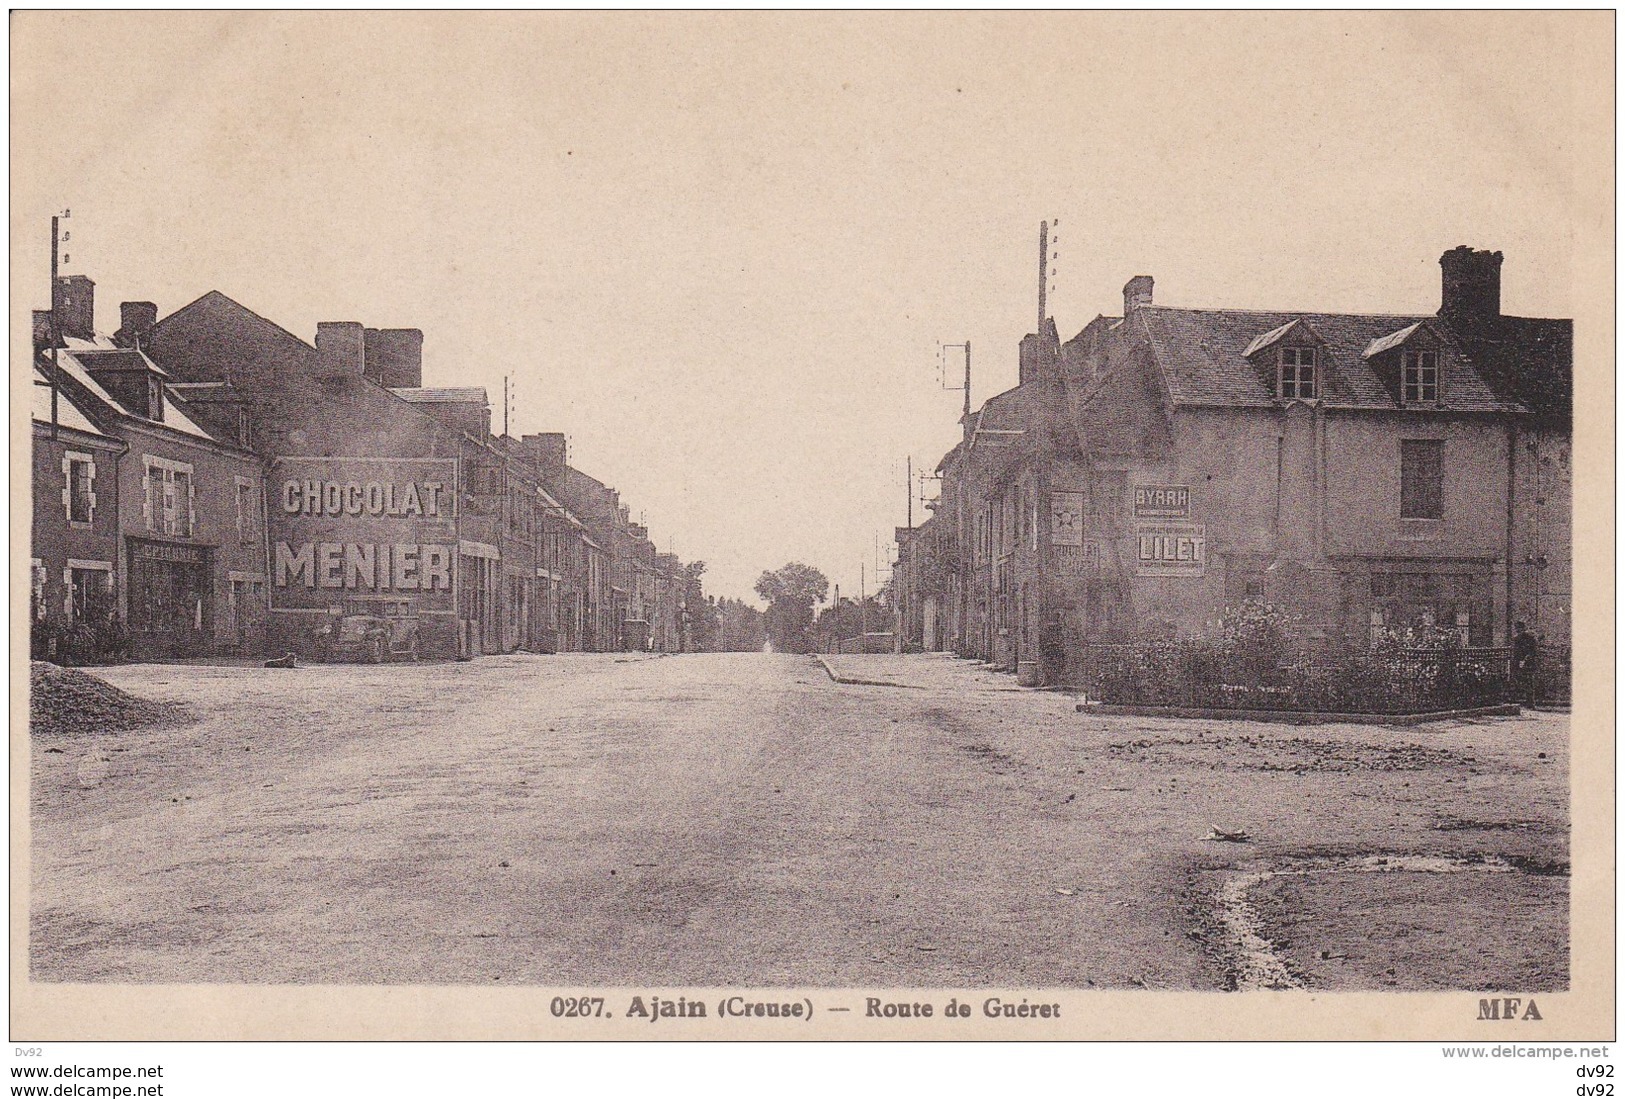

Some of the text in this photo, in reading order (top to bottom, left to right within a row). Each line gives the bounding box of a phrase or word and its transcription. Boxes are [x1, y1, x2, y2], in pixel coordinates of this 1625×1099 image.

[283, 478, 443, 517] CHOCOLAT
[1136, 489, 1187, 506] BYRRH
[1138, 536, 1204, 561] LILET
[275, 540, 451, 590] MENIER
